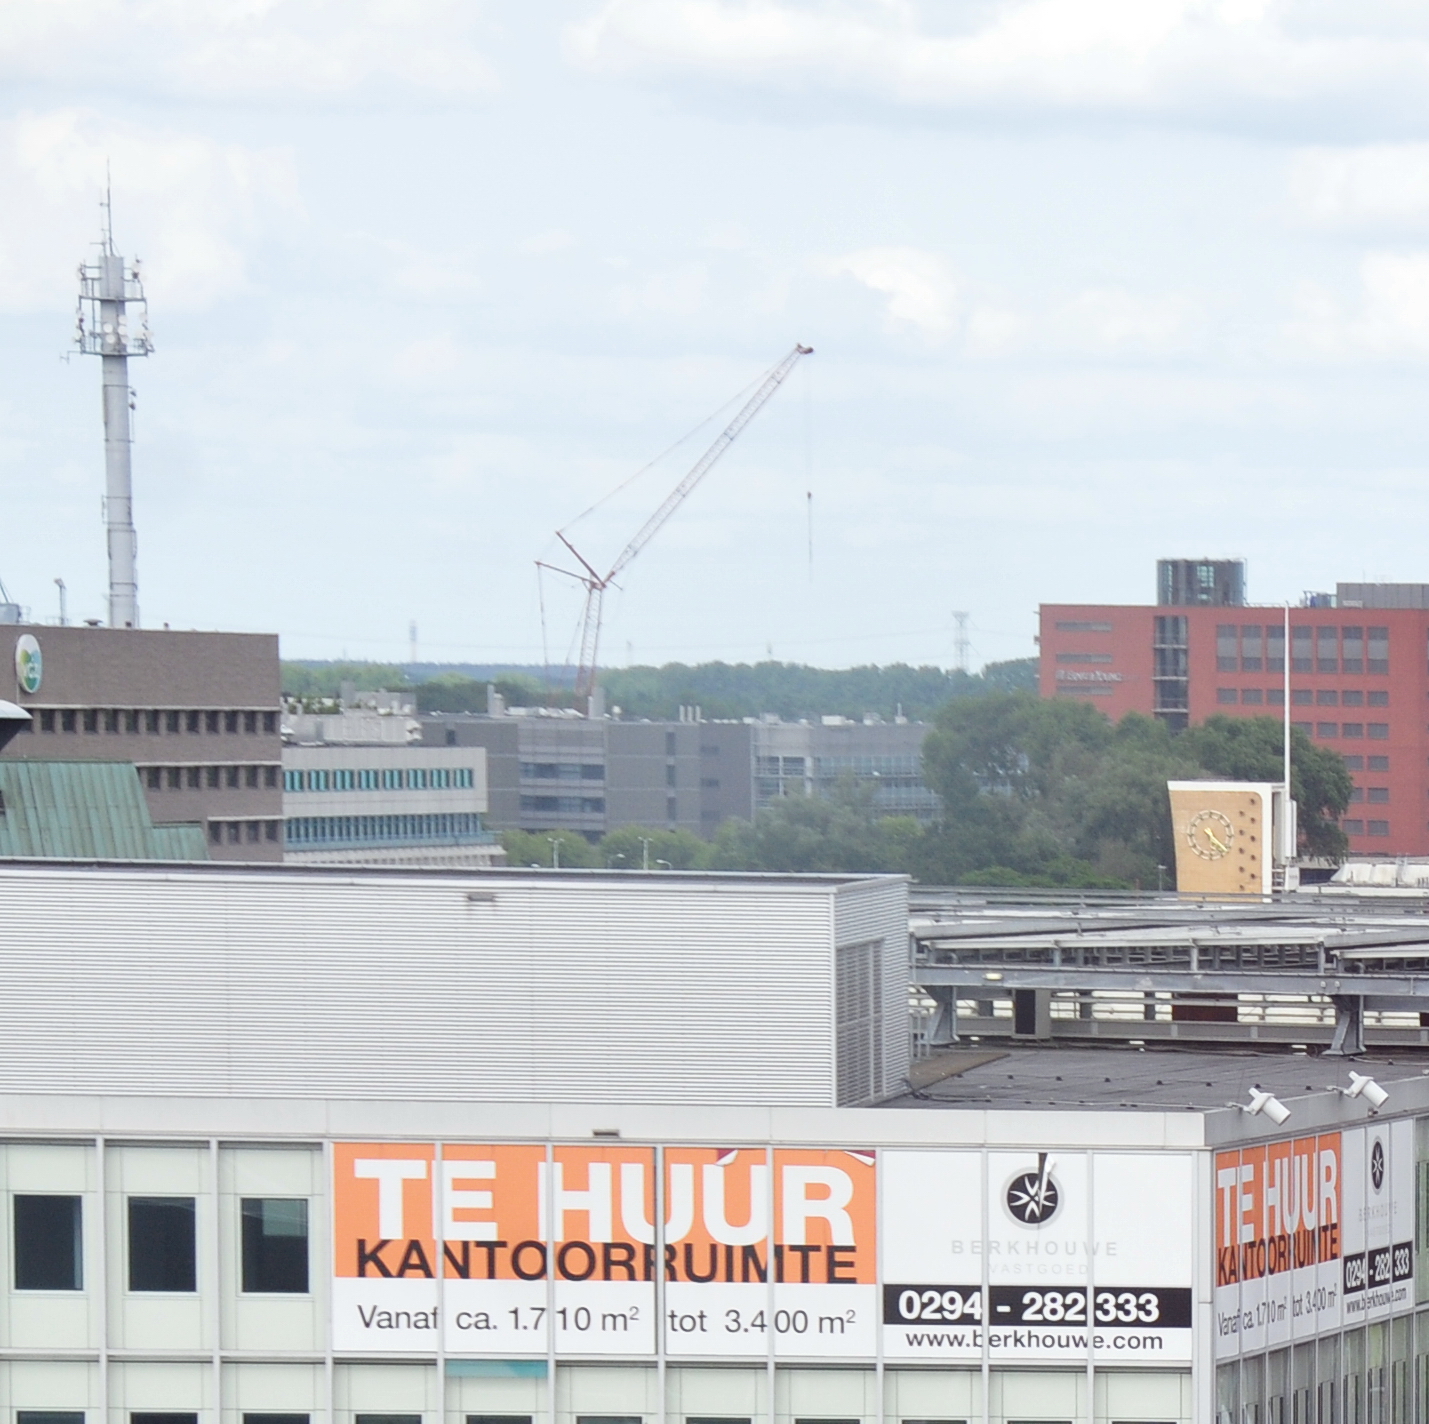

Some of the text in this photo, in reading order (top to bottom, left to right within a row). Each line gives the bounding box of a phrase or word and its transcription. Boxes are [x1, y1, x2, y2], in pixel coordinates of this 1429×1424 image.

[354, 1158, 855, 1247] TE HUUR
[1217, 1149, 1337, 1247] TE HUUR
[357, 1239, 857, 1285] KANTOORRUIMTE
[951, 1240, 1118, 1256] BERKHOUWE
[1218, 1223, 1338, 1286] KANTOORRUIMTE
[989, 1264, 1089, 1275] VASTGOED
[1346, 1258, 1366, 1288] 0294
[1375, 1252, 1390, 1282] 282
[1394, 1248, 1410, 1276] 333
[357, 1305, 439, 1330] Vanaf
[456, 1311, 498, 1331] ca.
[509, 1307, 591, 1332] 1.710
[669, 1310, 707, 1333] tot
[725, 1309, 808, 1333] 3.400
[899, 1290, 981, 1320] 0294
[1022, 1292, 1086, 1321] 282
[1096, 1293, 1159, 1322] 333
[906, 1330, 1163, 1350] www.berkhouwe.com
